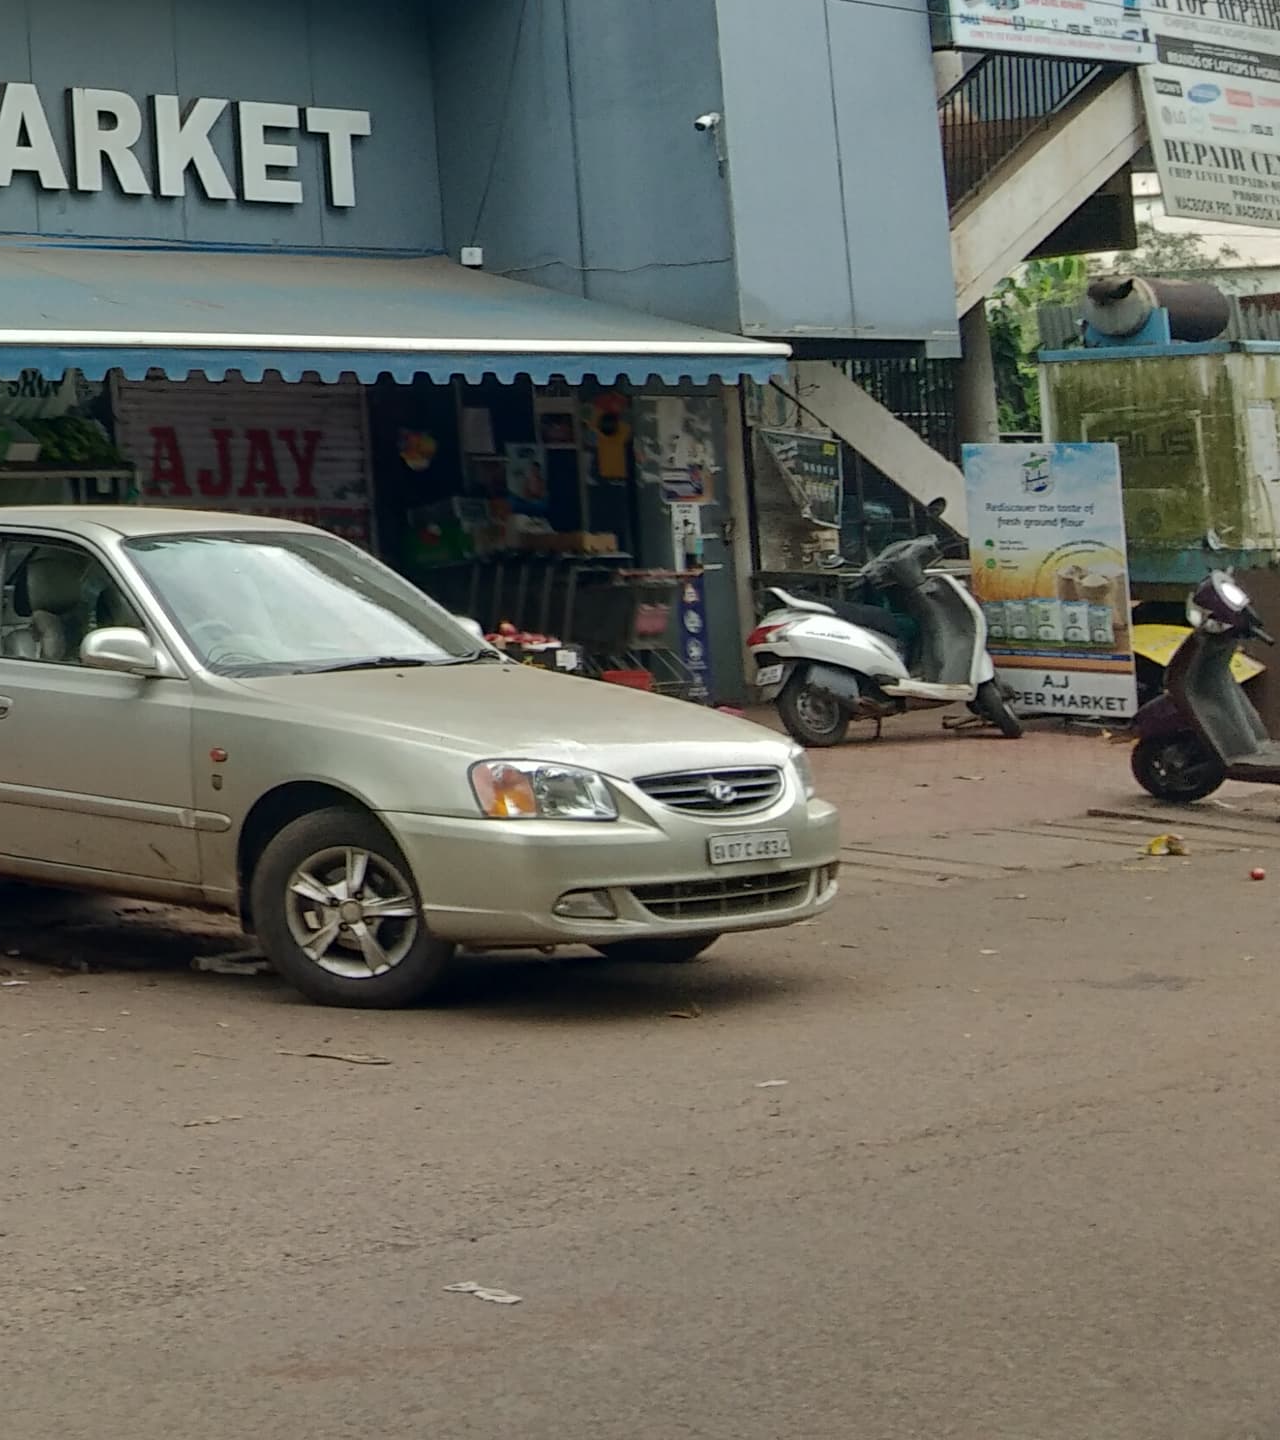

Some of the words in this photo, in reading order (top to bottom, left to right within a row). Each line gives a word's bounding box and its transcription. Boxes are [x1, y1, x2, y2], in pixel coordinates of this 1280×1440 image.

[1164, 138, 1246, 171] REPAIR
[143, 426, 323, 497] AJAY
[1038, 502, 1055, 513] the
[1084, 502, 1095, 516] of
[997, 516, 1021, 528] fresh
[1023, 516, 1058, 529] ground
[1060, 516, 1085, 528] flour
[1013, 691, 1046, 706] PER
[1051, 692, 1129, 712] MARKET
